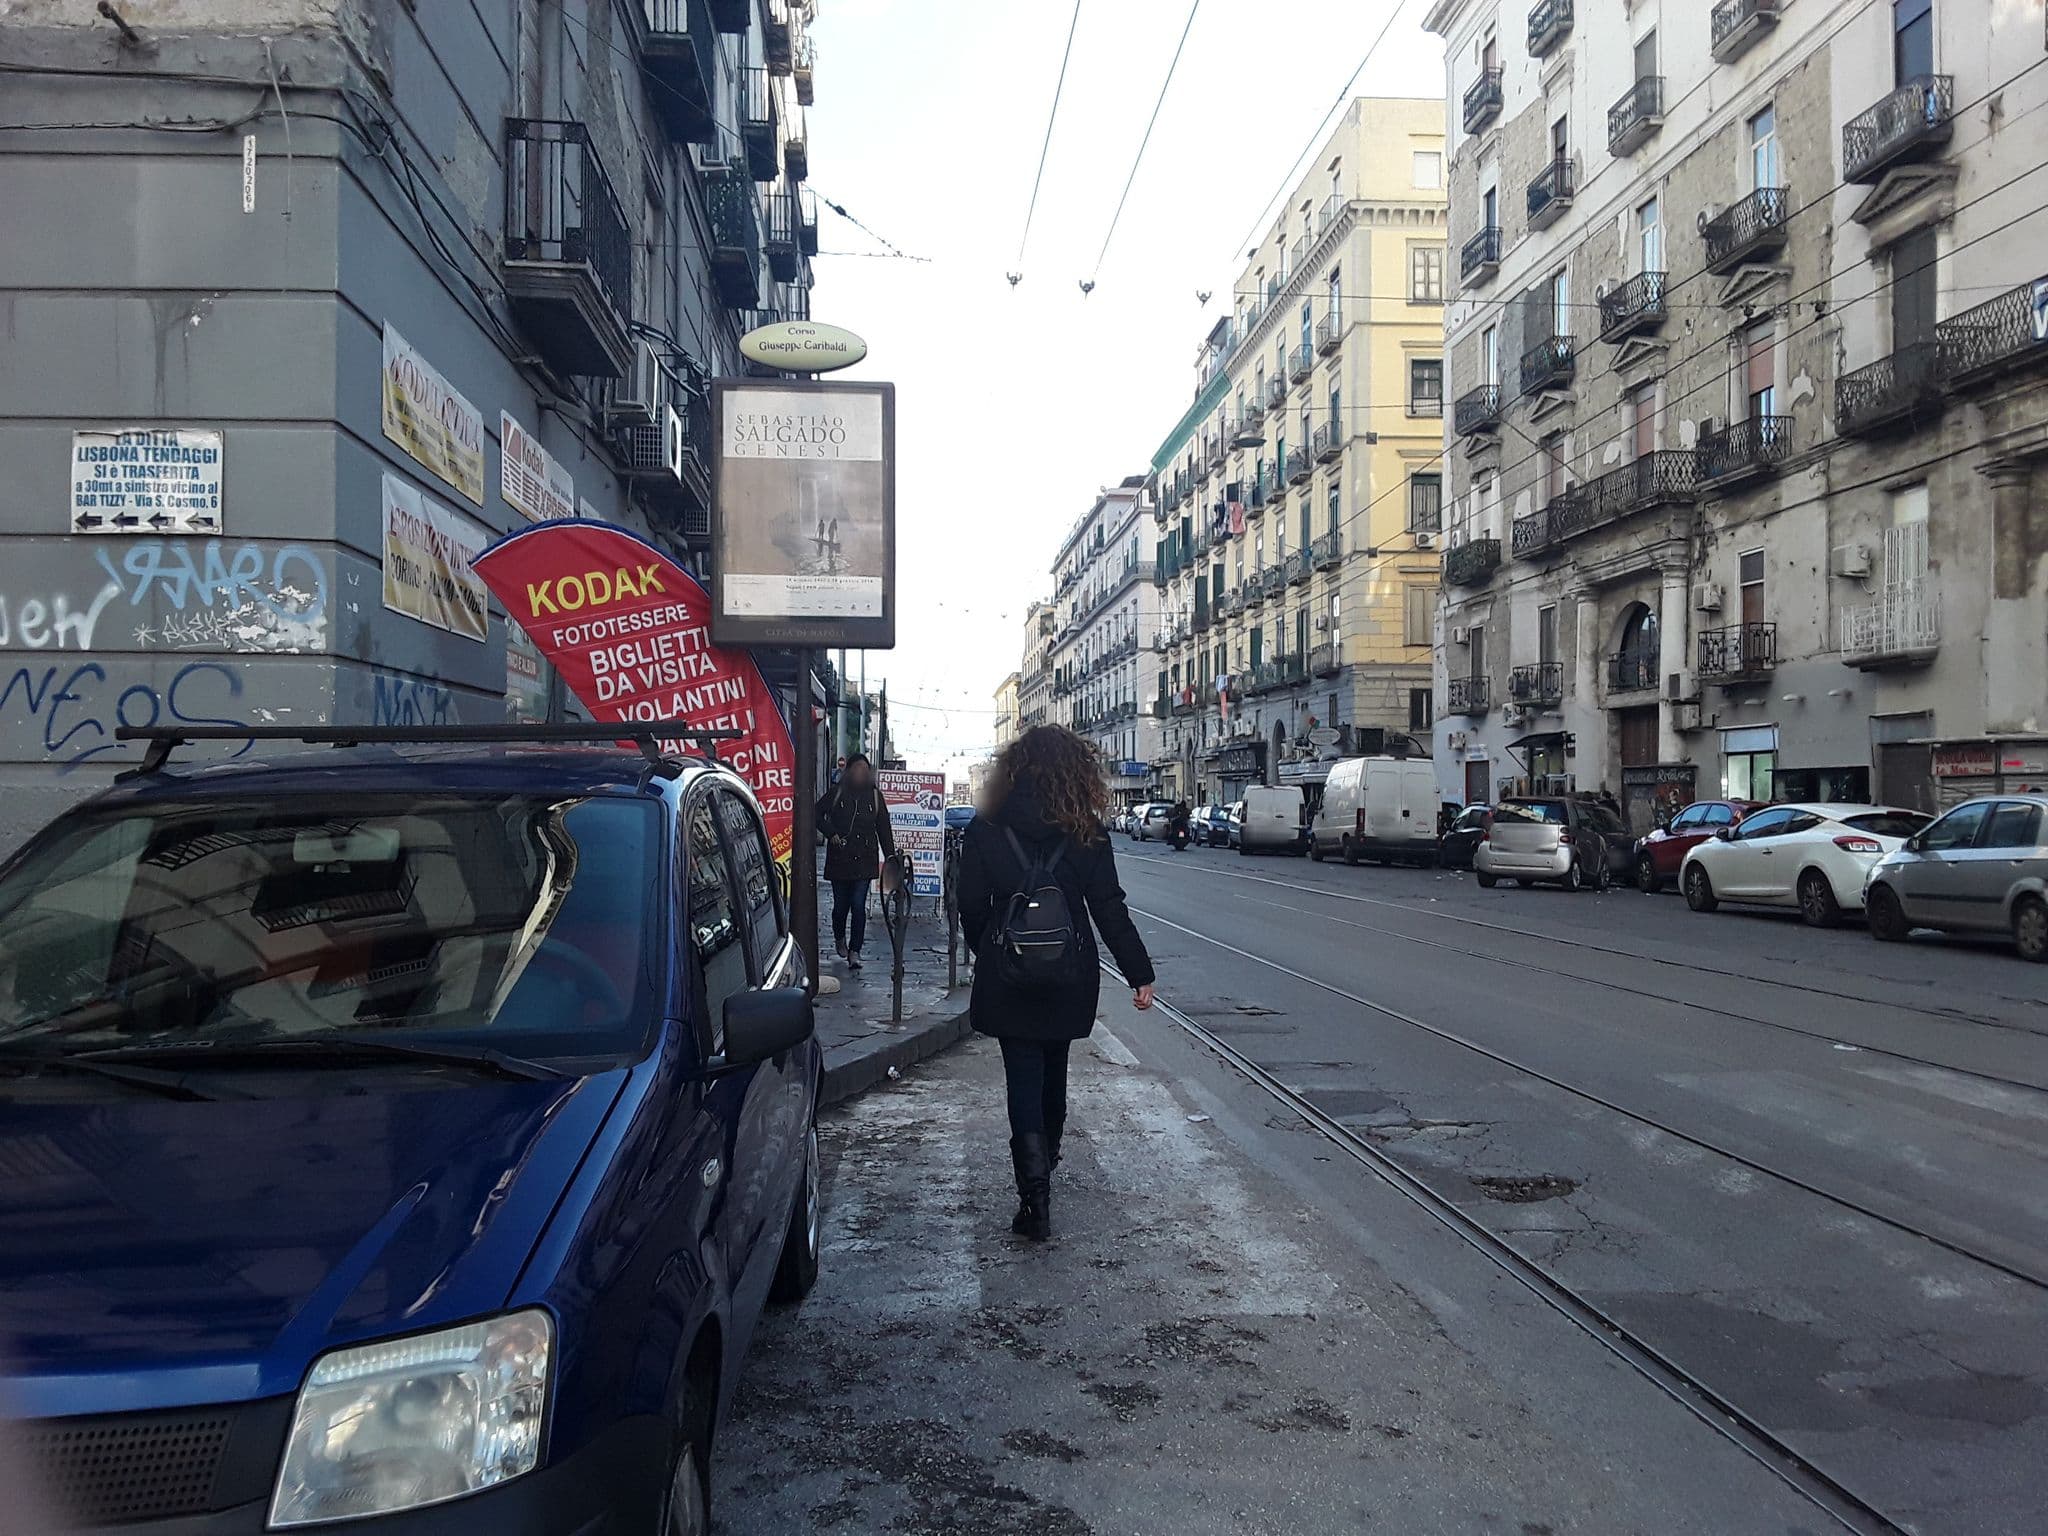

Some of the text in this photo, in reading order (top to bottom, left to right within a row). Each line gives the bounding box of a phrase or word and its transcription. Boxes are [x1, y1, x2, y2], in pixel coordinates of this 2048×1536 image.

[788, 327, 815, 335] Corso
[759, 341, 847, 352] Giuseppe Garibaldi
[136, 431, 178, 446] DITTA
[734, 425, 847, 444] SALGADO
[77, 446, 217, 464] LISBONA TENDAGGI
[522, 436, 545, 480] Kodak
[734, 443, 840, 458] GENESI
[94, 464, 107, 478] SI
[121, 465, 199, 479] TRASFERITA
[76, 480, 218, 494] a 30mt a sinistra vicino al
[76, 495, 97, 507] BAR
[100, 495, 126, 507] TIZZY
[135, 495, 151, 507] Via
[210, 496, 218, 508] 6
[526, 563, 665, 617] KODAK
[552, 604, 690, 648] FOTOTESSERE
[589, 625, 711, 675] BIGLIETTI
[596, 652, 717, 701] DA VISITA
[616, 676, 746, 723] VOLANTINI
[880, 773, 942, 784] FOTOTESSERA
[879, 782, 921, 791] ID PHOTO
